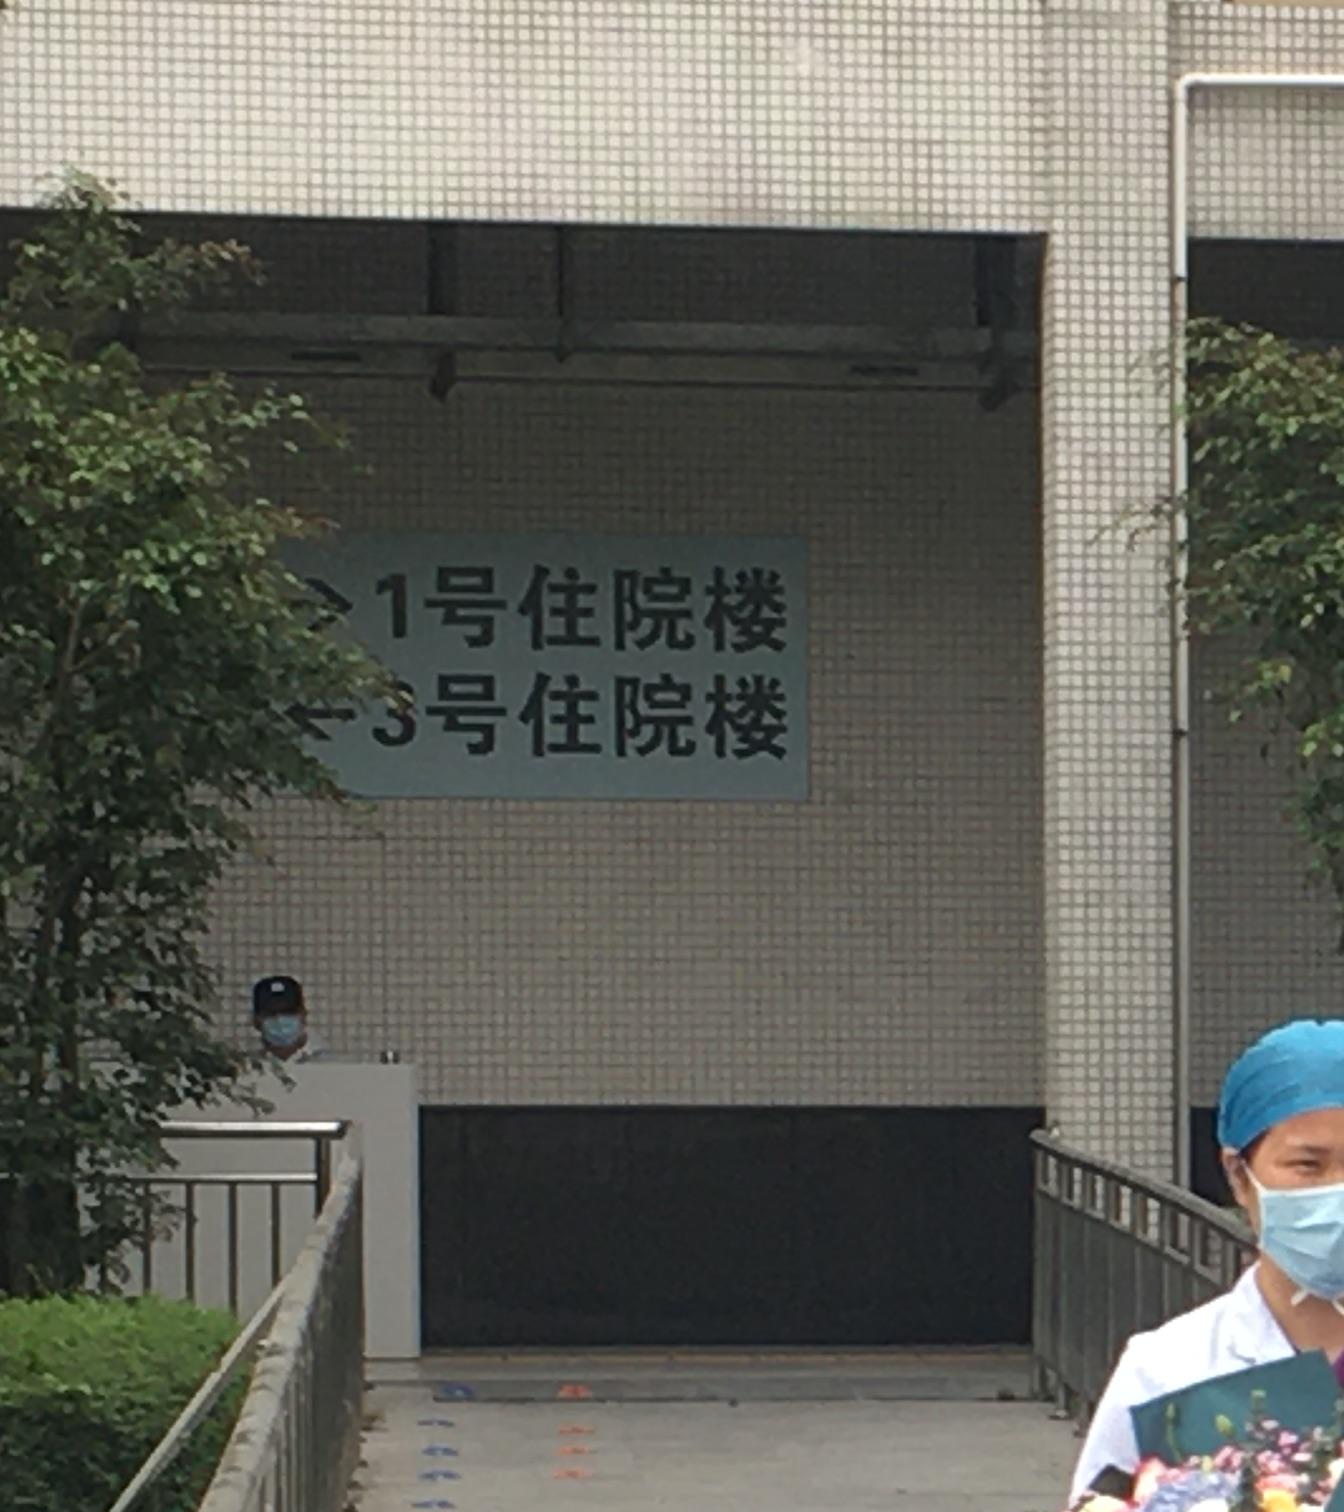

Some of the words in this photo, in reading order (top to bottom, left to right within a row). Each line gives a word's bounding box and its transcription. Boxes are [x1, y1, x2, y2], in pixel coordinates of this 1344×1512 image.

[375, 564, 788, 653] 1号住院楼
[371, 672, 788, 760] 3号住院楼
